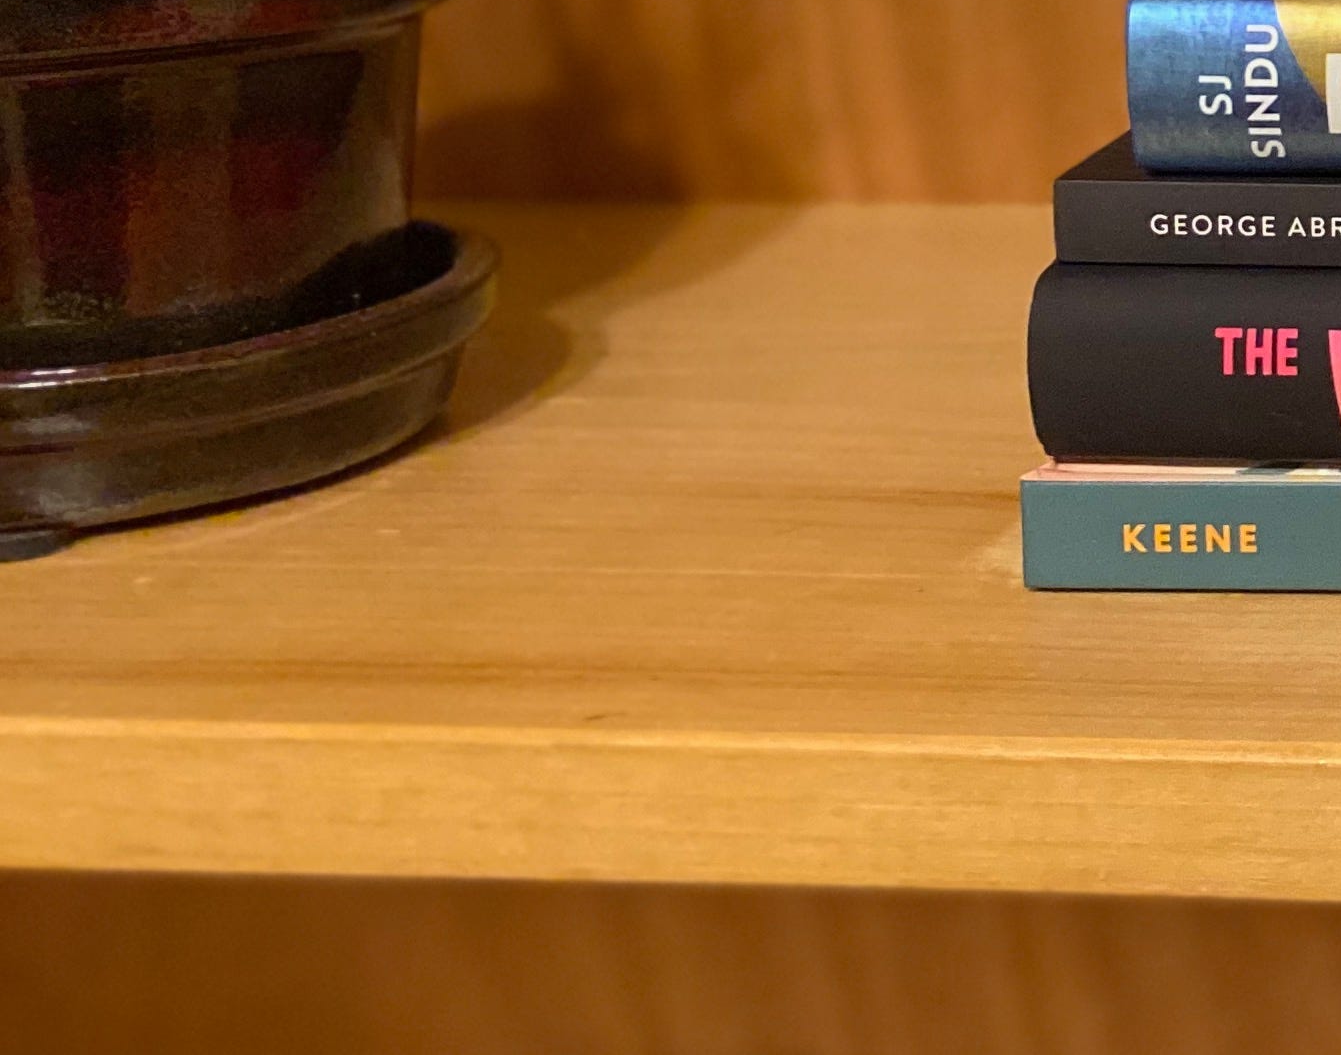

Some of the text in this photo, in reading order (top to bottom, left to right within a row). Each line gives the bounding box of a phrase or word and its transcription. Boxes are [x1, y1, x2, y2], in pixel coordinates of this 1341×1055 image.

[1198, 75, 1232, 115] SJ
[1243, 23, 1286, 158] SINDU
[1150, 214, 1277, 237] GEORGE
[1215, 327, 1299, 376] THE
[1123, 523, 1258, 553] KEENE
